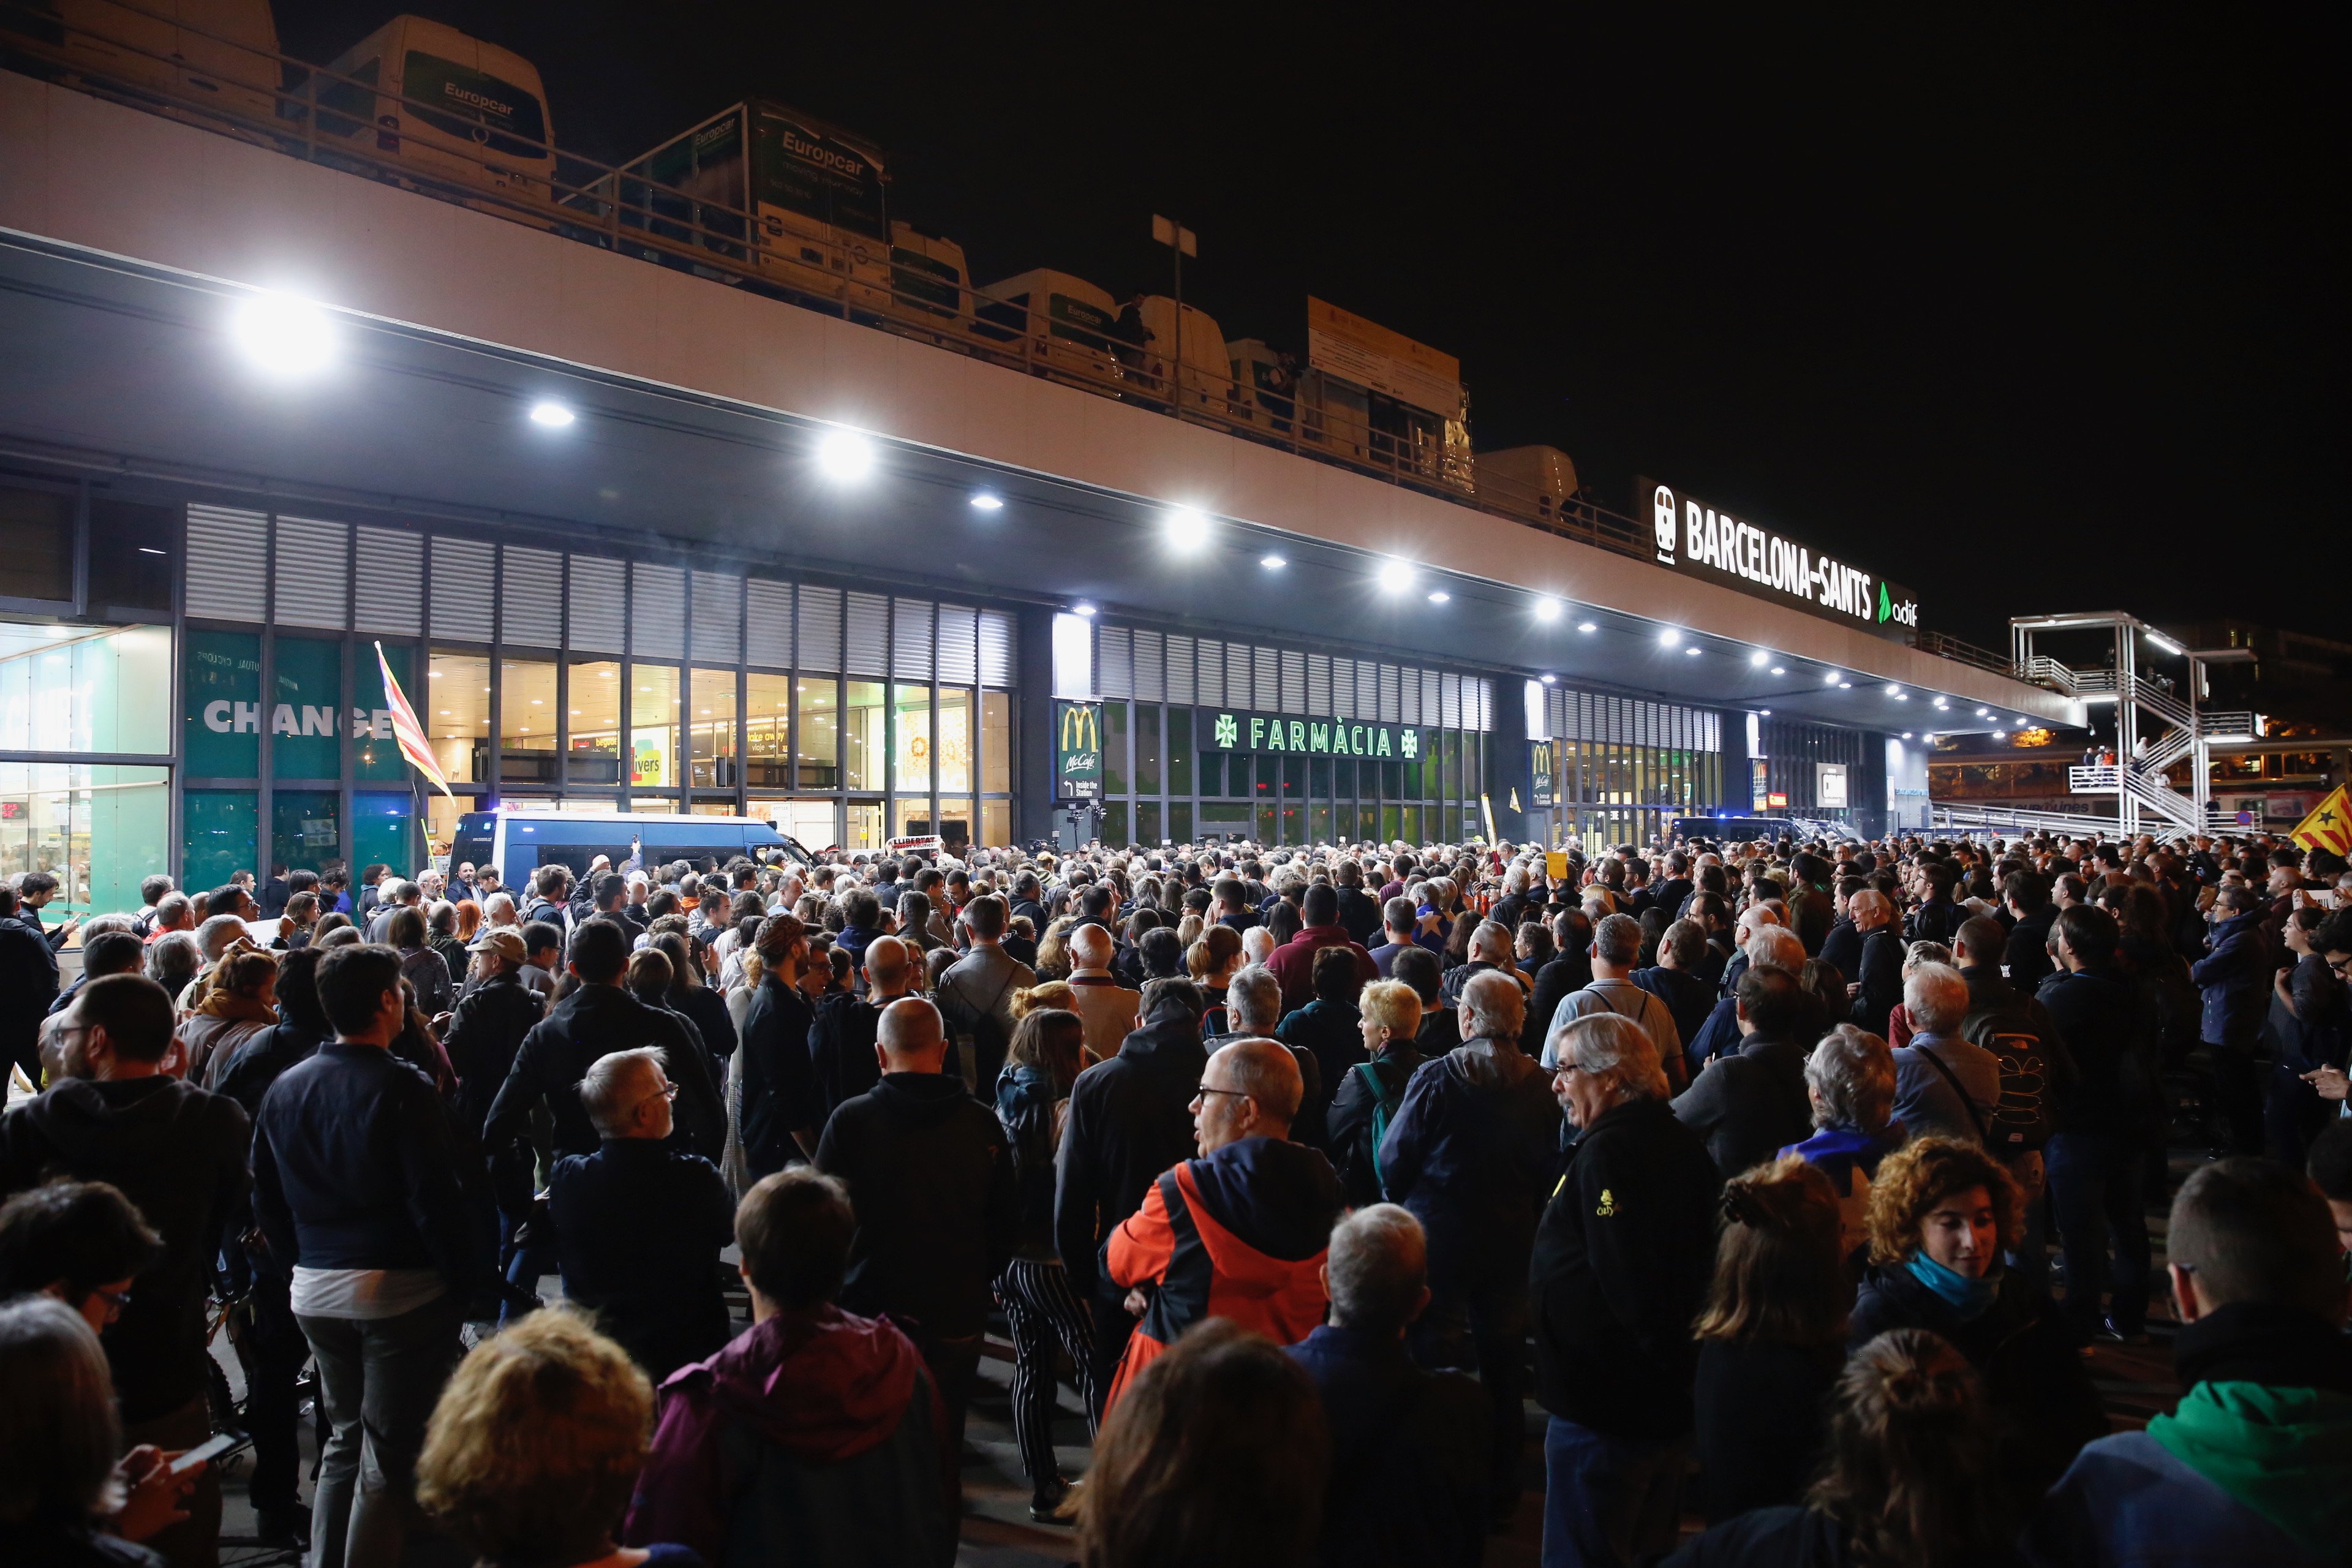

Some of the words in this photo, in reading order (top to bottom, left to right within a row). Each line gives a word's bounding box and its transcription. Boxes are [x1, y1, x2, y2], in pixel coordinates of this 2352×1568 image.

[445, 81, 514, 115] Europcar
[696, 118, 735, 145] Europcar
[782, 130, 864, 175] Europcar
[1068, 304, 1102, 325] Europcar
[1686, 500, 1872, 621] BARCELONA-SANTS
[1892, 603, 1918, 628] adif
[204, 699, 392, 739] CHANGE
[747, 732, 763, 742] take
[1251, 715, 1392, 757] FARMÀCIA
[1066, 753, 1095, 772] McCafé
[1076, 780, 1089, 789] Inside
[894, 837, 935, 845] LLIBERTAT
